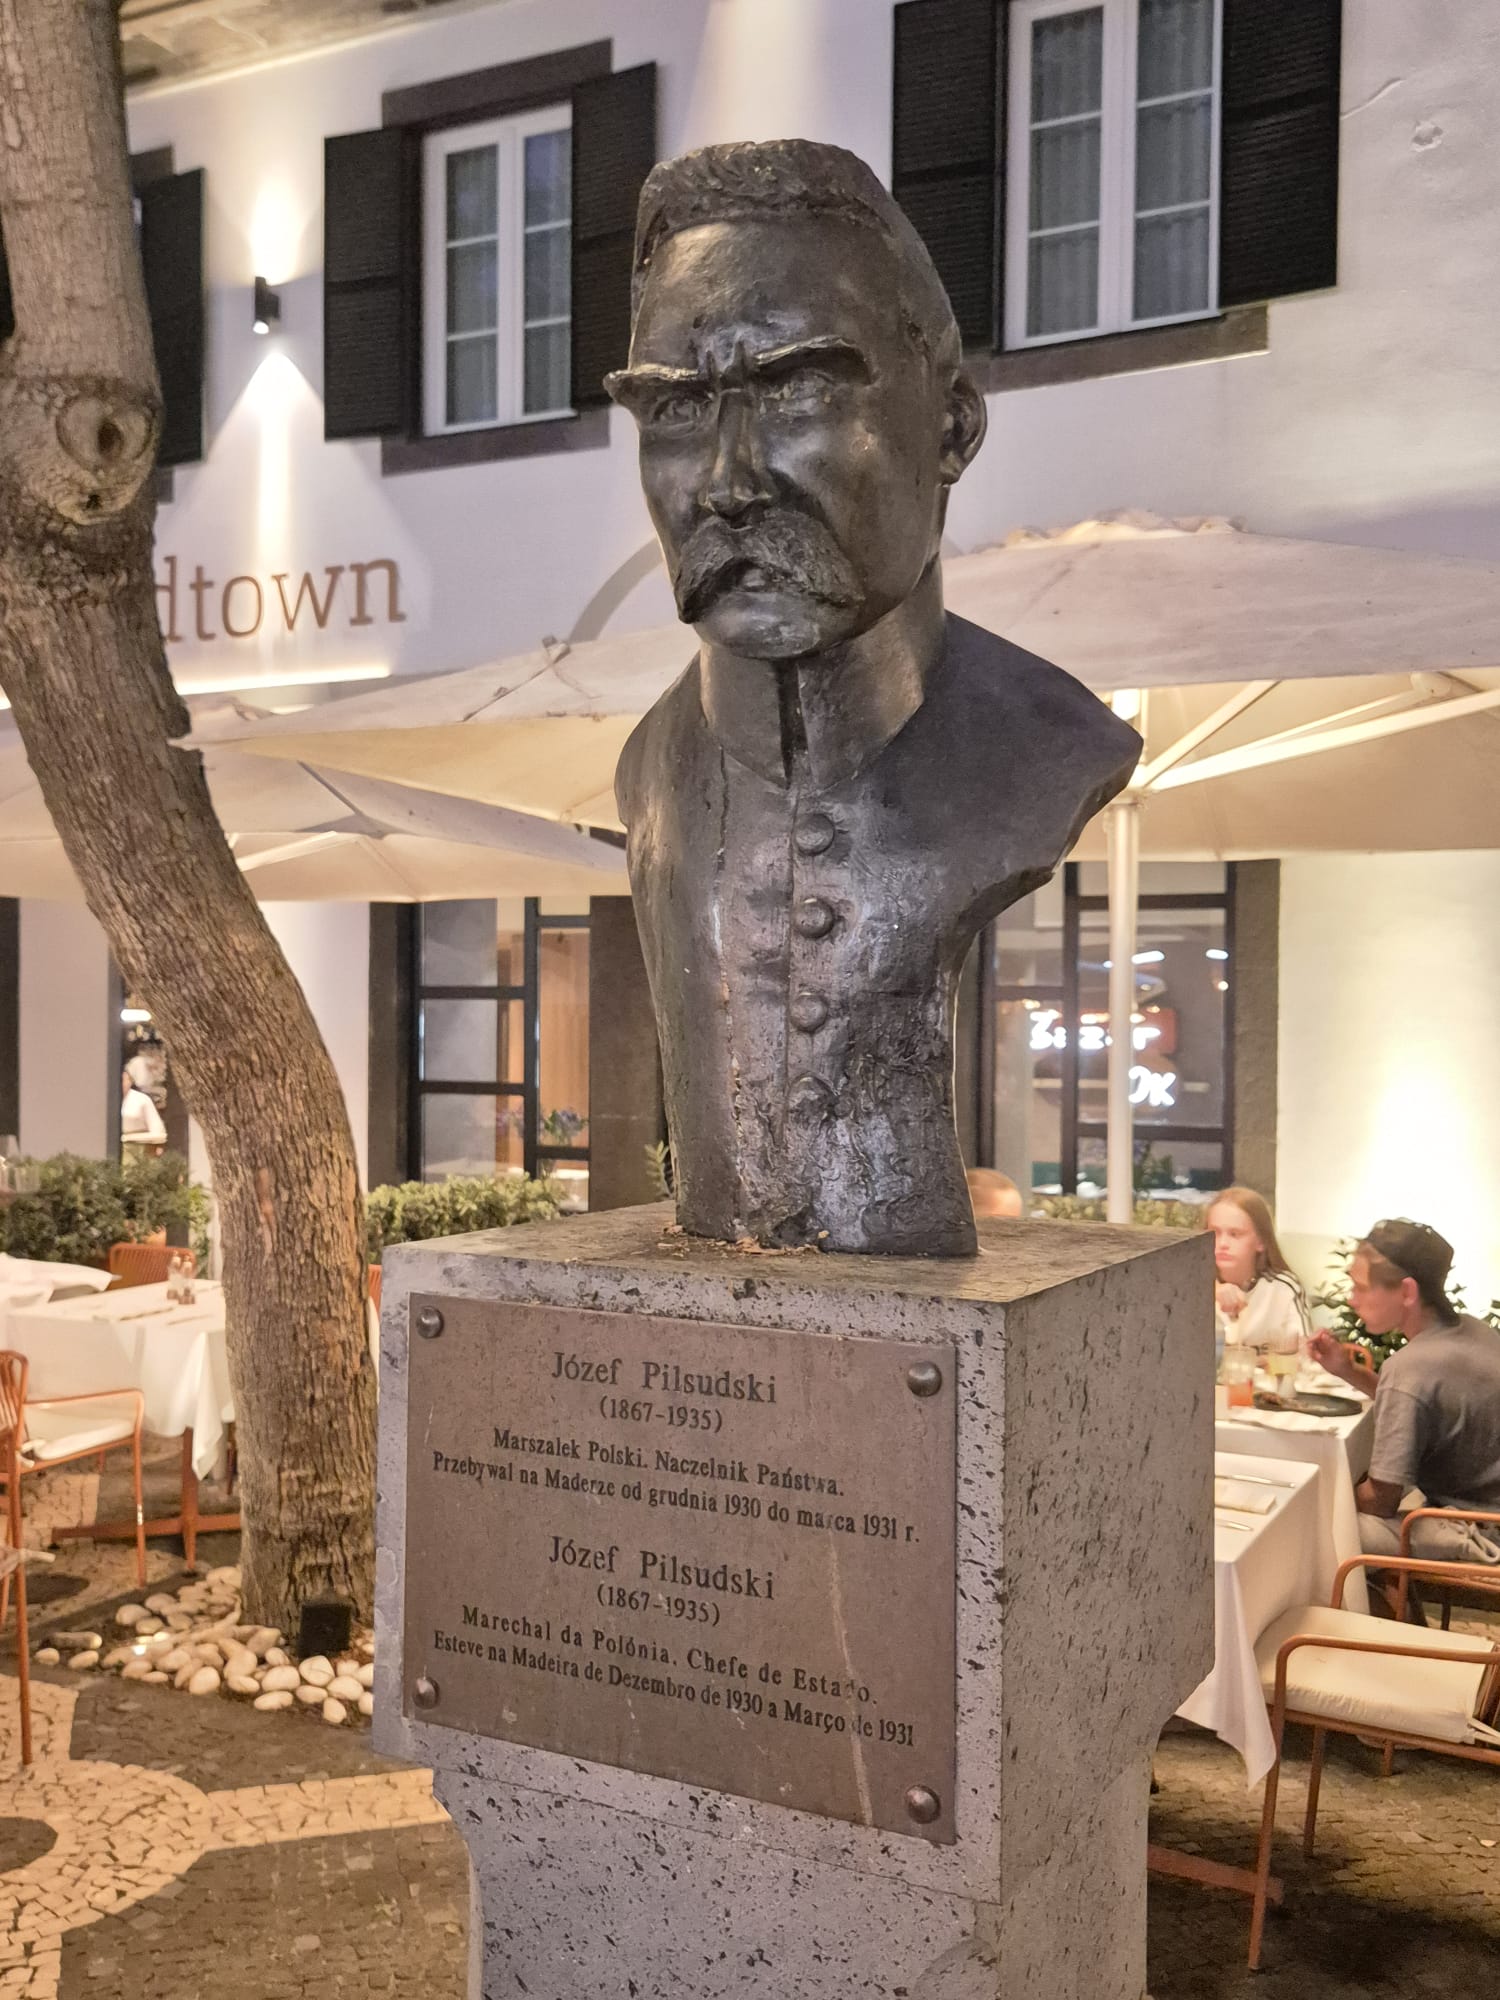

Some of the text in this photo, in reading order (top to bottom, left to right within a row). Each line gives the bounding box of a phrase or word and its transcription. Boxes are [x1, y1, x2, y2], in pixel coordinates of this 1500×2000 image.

[551, 1351, 777, 1403] Józef Pilsudski
[599, 1395, 723, 1433] (1867-1935)
[493, 1427, 581, 1460] Marszalek
[587, 1441, 649, 1468] Polski.
[655, 1450, 750, 1483] Naczelnik
[433, 1451, 513, 1482] Przebywal
[519, 1468, 539, 1486] na
[544, 1467, 615, 1497] Maderze
[621, 1481, 642, 1501] od
[648, 1488, 718, 1513] grudnia
[724, 1493, 762, 1520] 1930
[767, 1501, 790, 1523] do
[863, 1513, 898, 1541] 1931
[905, 1524, 921, 1543] r.
[548, 1535, 775, 1600] Józef Pilsudski
[462, 1604, 551, 1641] Marechal
[560, 1624, 583, 1647] da
[592, 1628, 678, 1666] Polónia.
[686, 1648, 749, 1679] Chefe
[758, 1662, 783, 1685] de
[433, 1630, 484, 1658] Esteve
[488, 1645, 507, 1663] na
[512, 1645, 579, 1678] Madeira
[584, 1660, 603, 1682] de
[608, 1664, 695, 1702] Dezembro
[701, 1684, 722, 1706] de
[726, 1688, 763, 1716] 1930
[768, 1702, 778, 1719] a
[783, 1699, 846, 1734] Março
[878, 1718, 914, 1747] 1931
